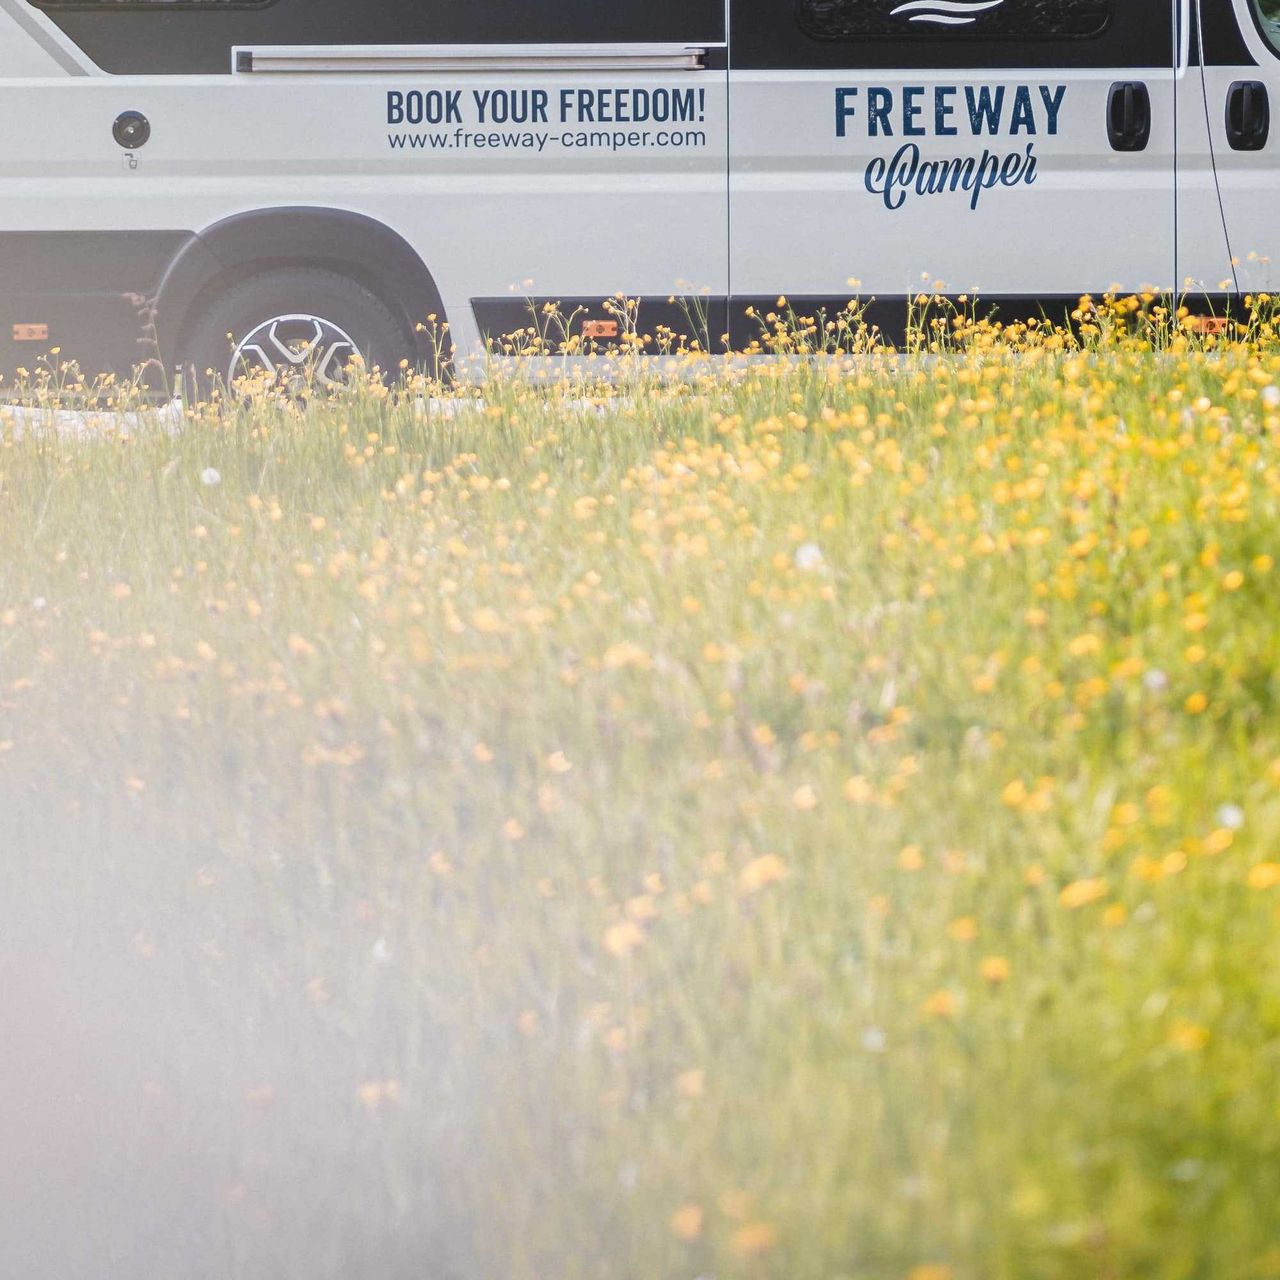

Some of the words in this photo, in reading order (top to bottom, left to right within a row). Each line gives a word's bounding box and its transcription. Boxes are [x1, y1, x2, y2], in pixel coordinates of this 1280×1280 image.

[387, 90, 463, 124] BOOK
[472, 89, 549, 123] YOUR
[560, 88, 705, 122] FREEDOM!
[835, 85, 1067, 137] FREEWAY
[388, 128, 706, 152] www.freeway-camper.com
[864, 142, 1037, 210] Camper
